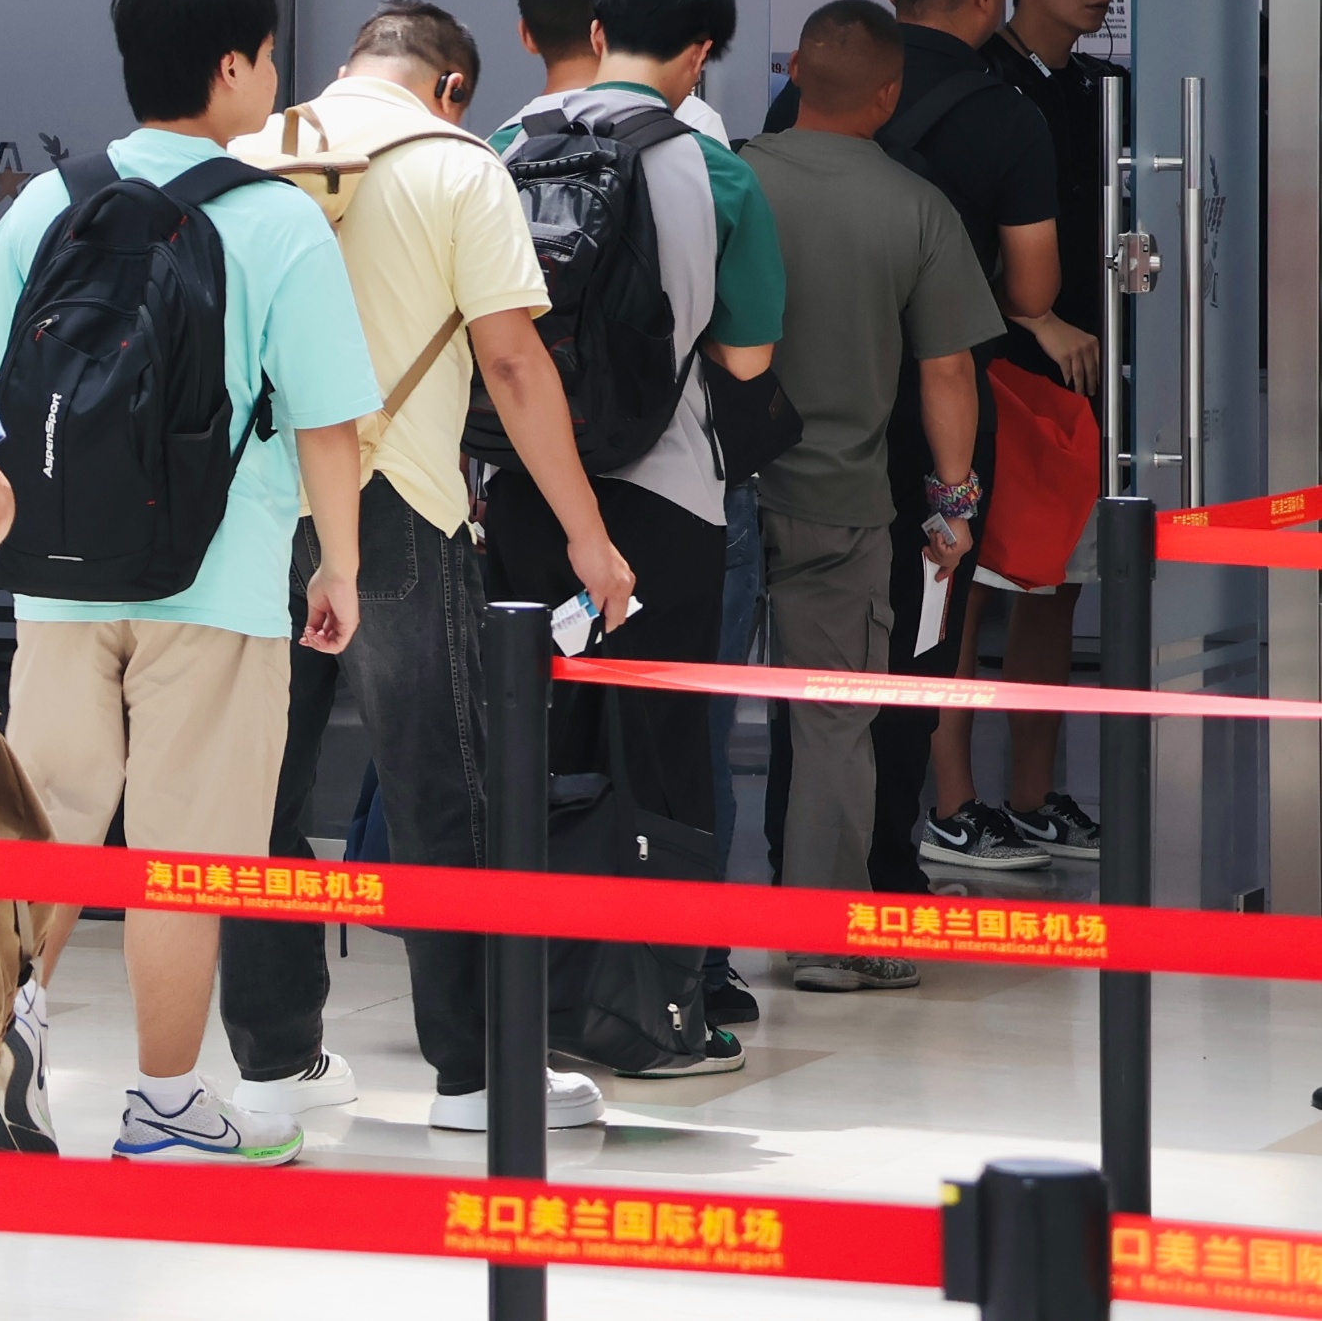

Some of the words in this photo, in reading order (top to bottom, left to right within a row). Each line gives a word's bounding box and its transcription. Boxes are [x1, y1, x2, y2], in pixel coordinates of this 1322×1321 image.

[43, 393, 62, 479] AspenSport
[146, 861, 384, 901] 海口美兰国际机场
[847, 903, 1107, 943] 海口美兰国际机场
[447, 1192, 783, 1249] 海口美兰国际机场
